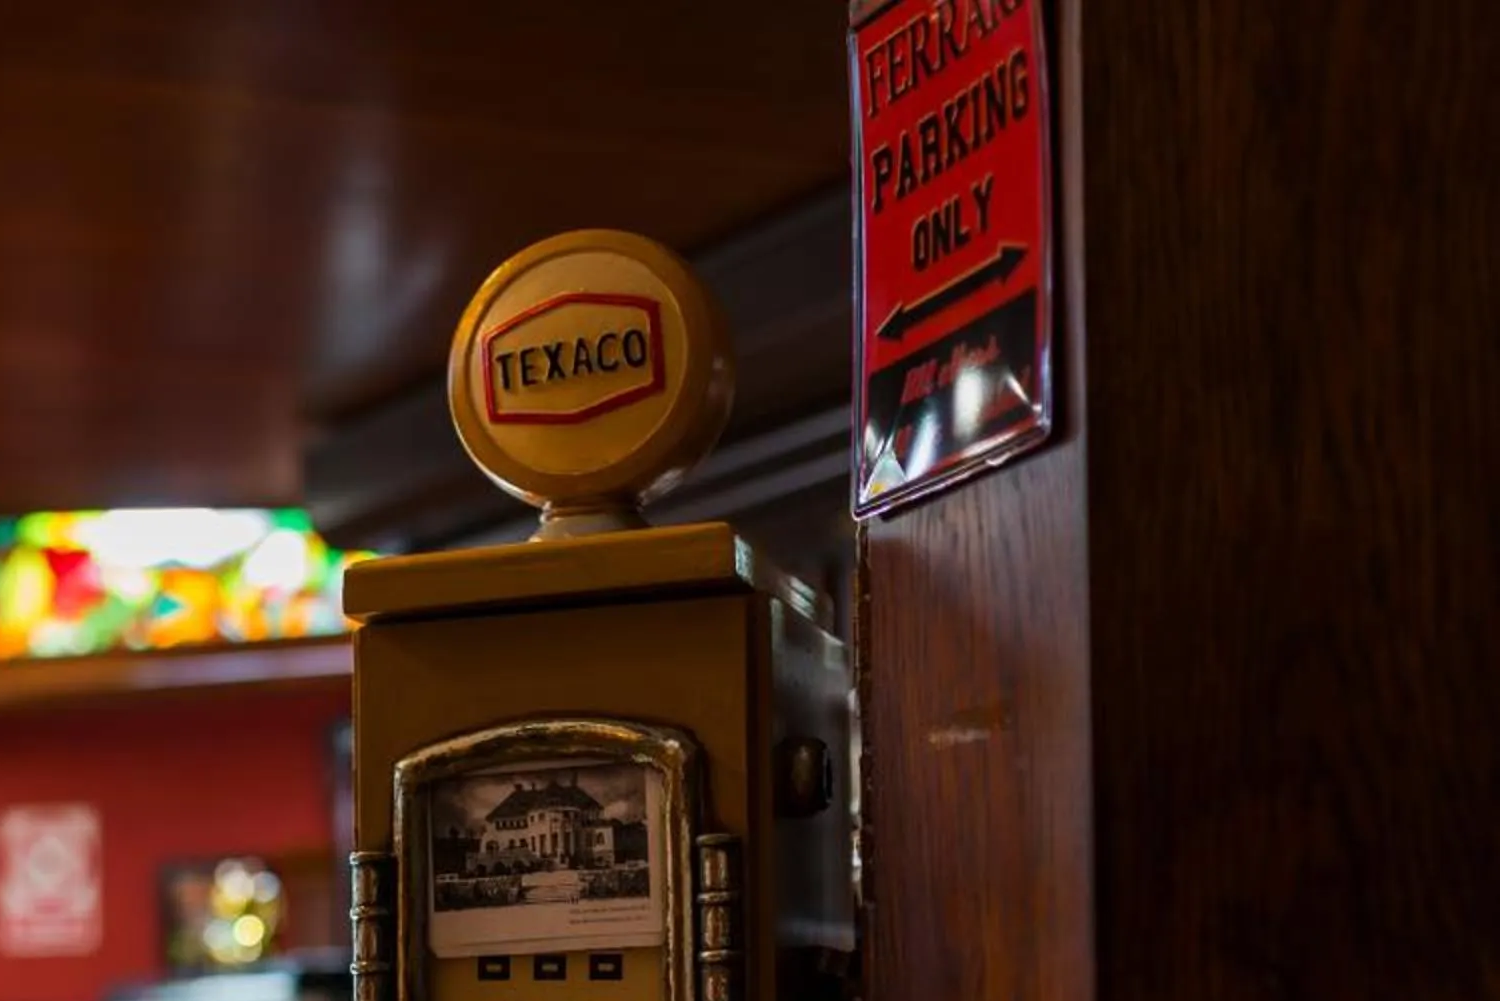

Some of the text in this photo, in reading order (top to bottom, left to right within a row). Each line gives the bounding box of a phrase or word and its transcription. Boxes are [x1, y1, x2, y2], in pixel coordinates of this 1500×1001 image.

[865, 0, 1024, 118] FERRA
[871, 46, 1028, 215] PARKING
[912, 172, 994, 271] ONLY
[496, 328, 648, 390] TEXACO
